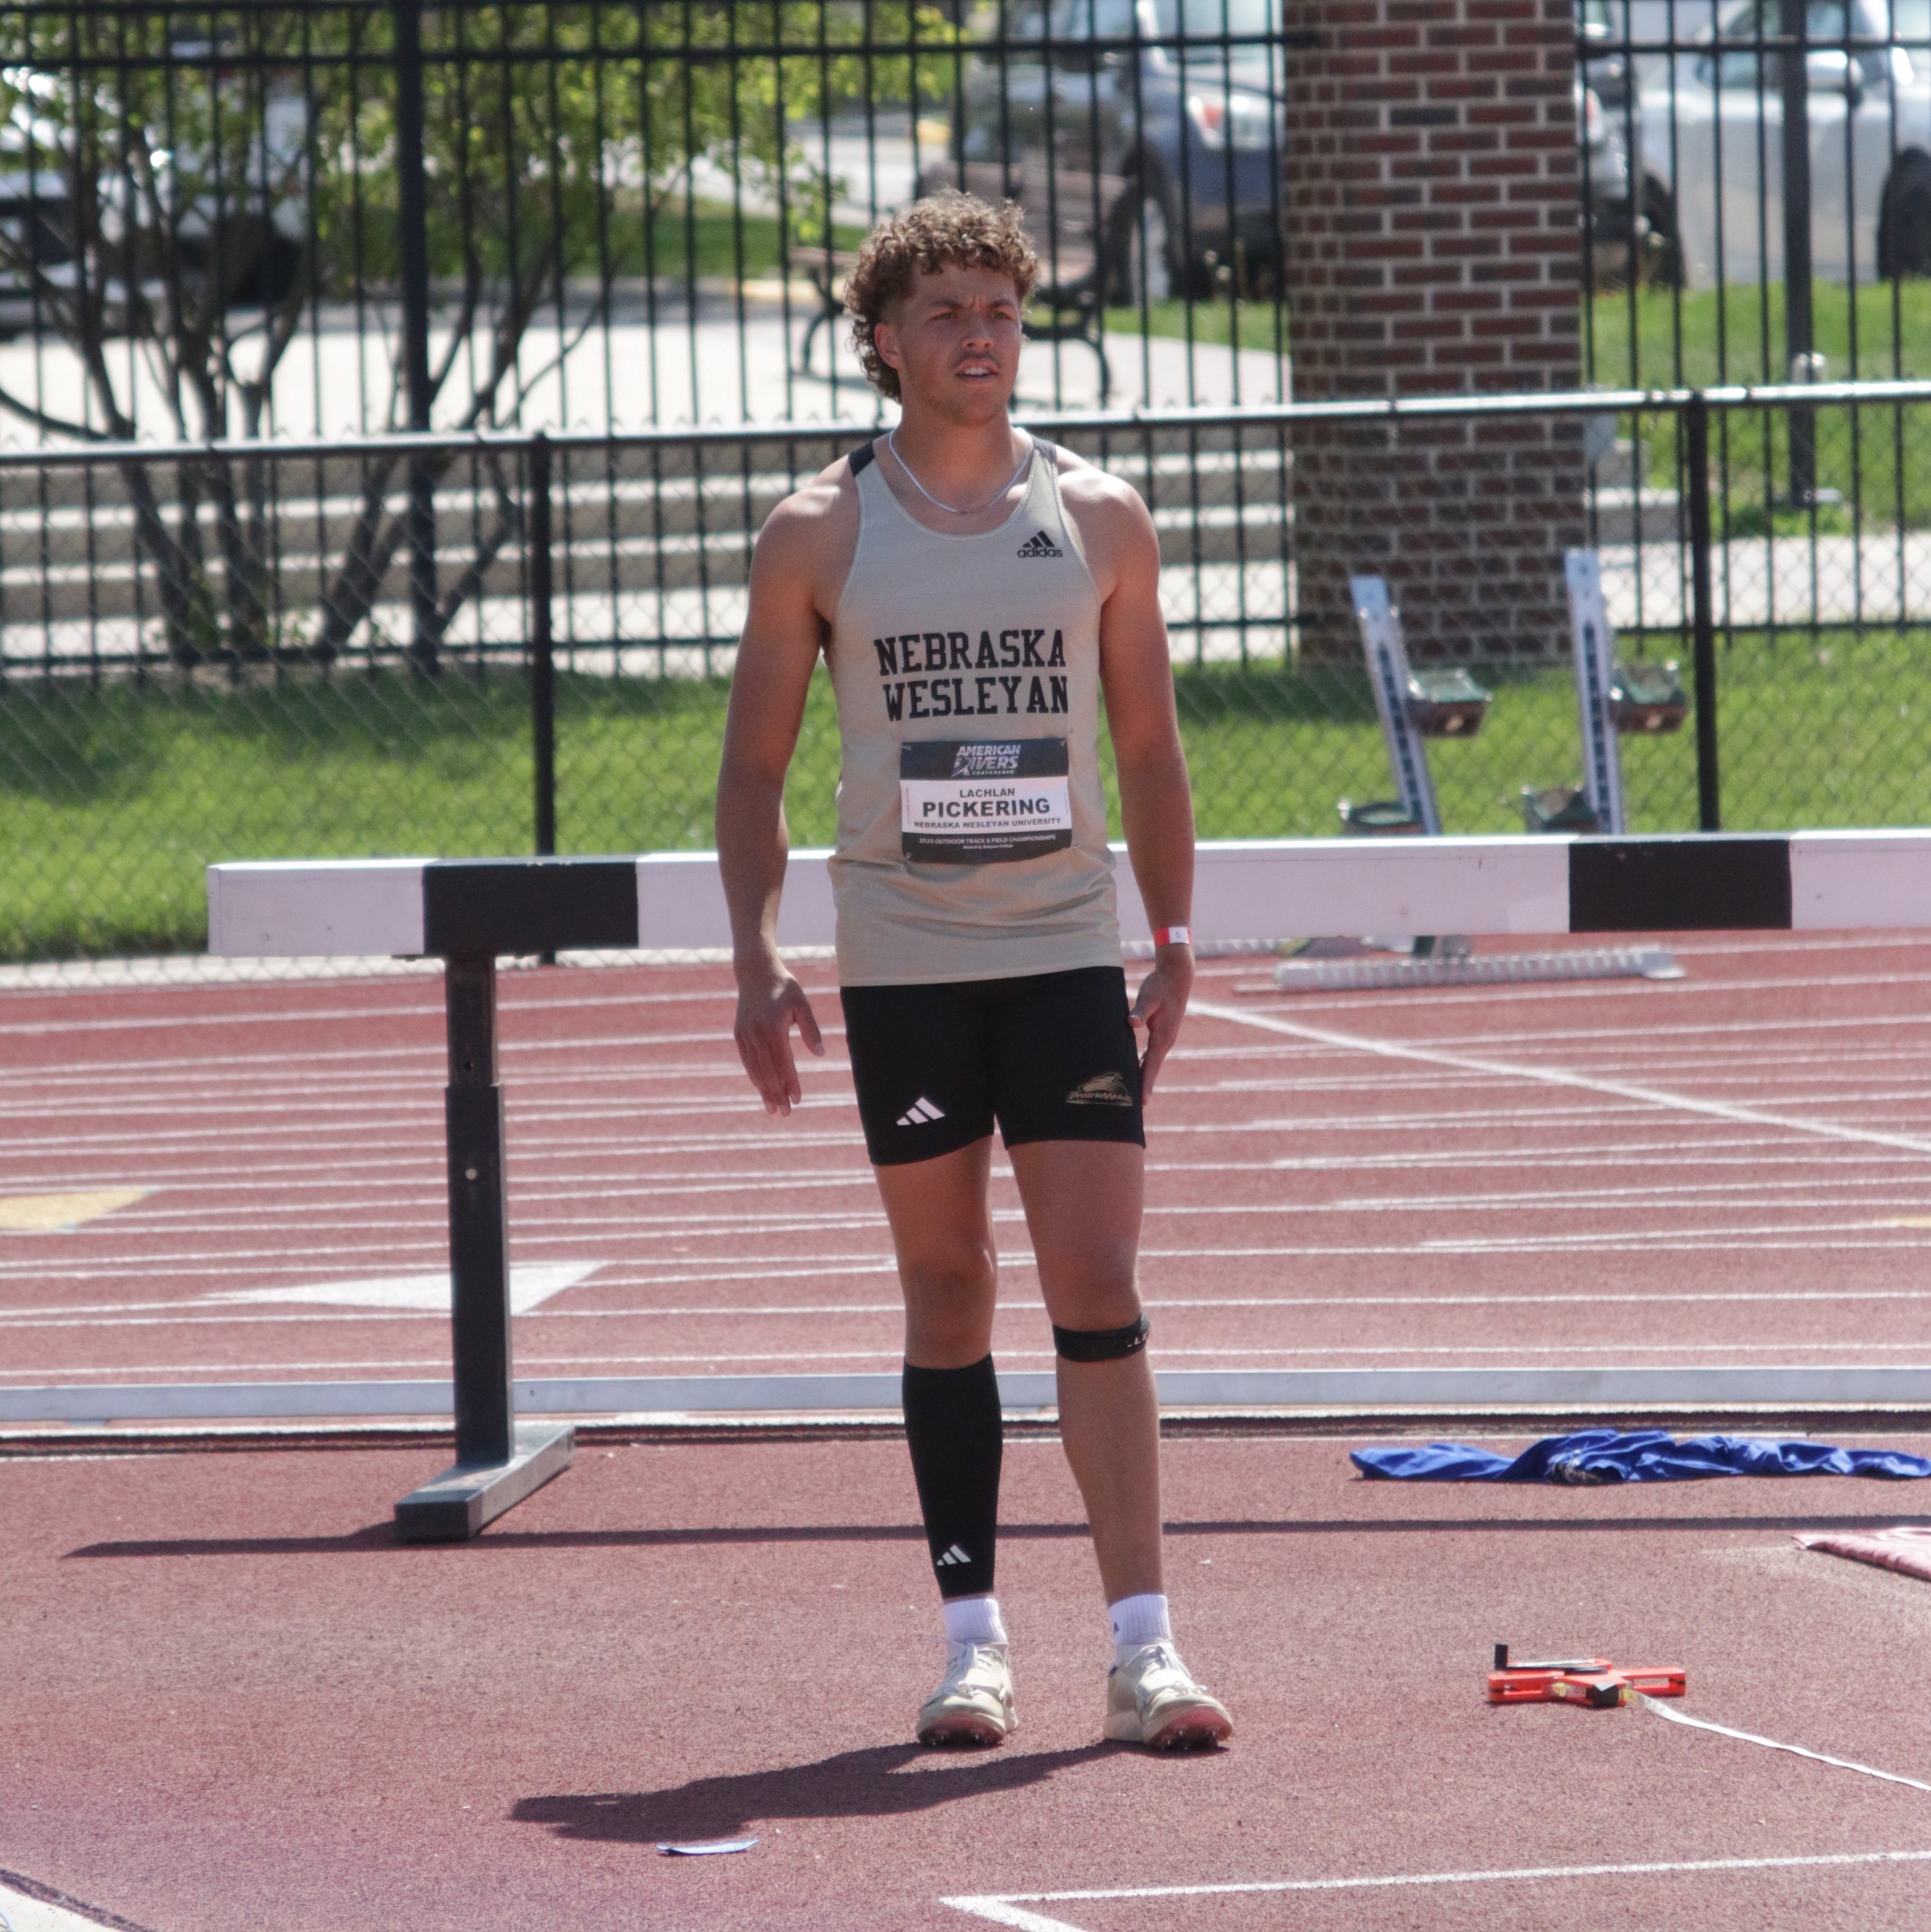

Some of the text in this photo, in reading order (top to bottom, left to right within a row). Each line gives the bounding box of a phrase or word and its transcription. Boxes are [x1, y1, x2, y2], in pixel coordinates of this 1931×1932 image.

[1017, 547, 1063, 558] adidas
[873, 629, 1066, 676] NEBRASKA
[882, 676, 1068, 722] WESLEYAN
[956, 744, 1021, 757] AMERICAN
[960, 788, 1015, 798] LACHLAN
[923, 798, 1050, 818] PICKERING
[1012, 817, 1061, 826] UNIVERSITY
